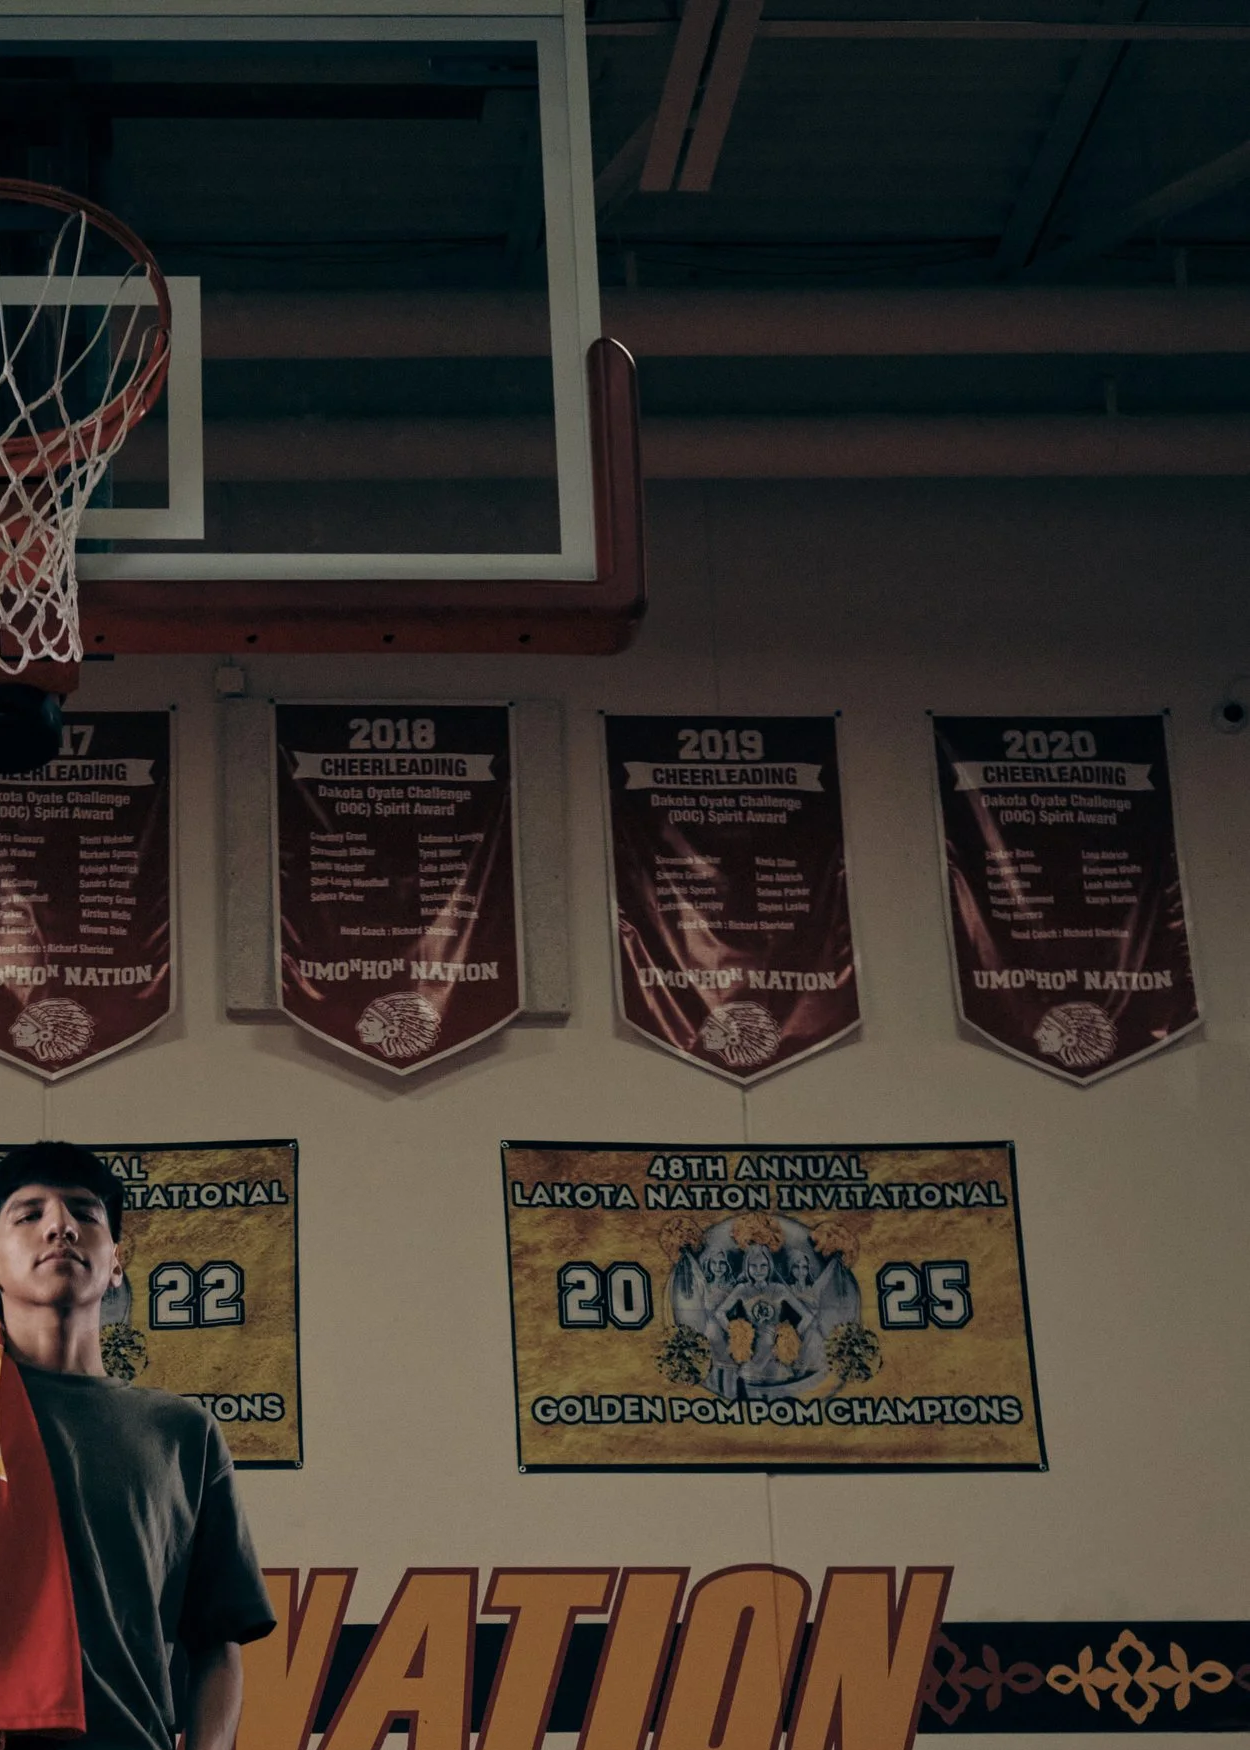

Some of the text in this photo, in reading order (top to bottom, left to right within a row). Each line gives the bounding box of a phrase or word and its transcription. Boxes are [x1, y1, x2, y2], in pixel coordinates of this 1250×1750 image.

[58, 725, 95, 756] 17
[348, 718, 436, 750] 2018
[677, 729, 764, 761] 2019
[1002, 729, 1098, 760] 2020
[321, 758, 467, 777] CHEERLEADING
[652, 768, 798, 786] CHEERLEADING
[982, 766, 1126, 786] CHEERLEADING
[27, 791, 64, 806] Oyate
[66, 791, 131, 807] Challenge
[318, 784, 472, 802] Dakota Oyate Challenge
[650, 794, 802, 811] Dakota Oyate Challenge
[981, 794, 1132, 812] Dakota Oyate Challenge
[34, 806, 71, 821] Spirit
[72, 807, 115, 821] Award
[375, 802, 411, 817] Spirit
[414, 803, 455, 816] Award
[708, 810, 745, 825] Spirit
[747, 811, 787, 824] Award
[1039, 811, 1075, 826] Spirit
[1077, 812, 1117, 825] Award
[64, 964, 153, 987] NATION
[410, 960, 499, 982] NATION
[748, 970, 837, 992] NATION
[1083, 969, 1174, 992] NATION
[647, 1155, 867, 1181] 48TH ANNUAL
[123, 1180, 289, 1211] TATIONAL
[512, 1181, 1007, 1210] LAKOTA NATION INVITATIONAL
[150, 1261, 246, 1330] 22
[557, 1260, 653, 1330] 20
[876, 1260, 973, 1330] 25
[531, 1395, 1024, 1425] GOLDEN POM POM CHAMPIONS
